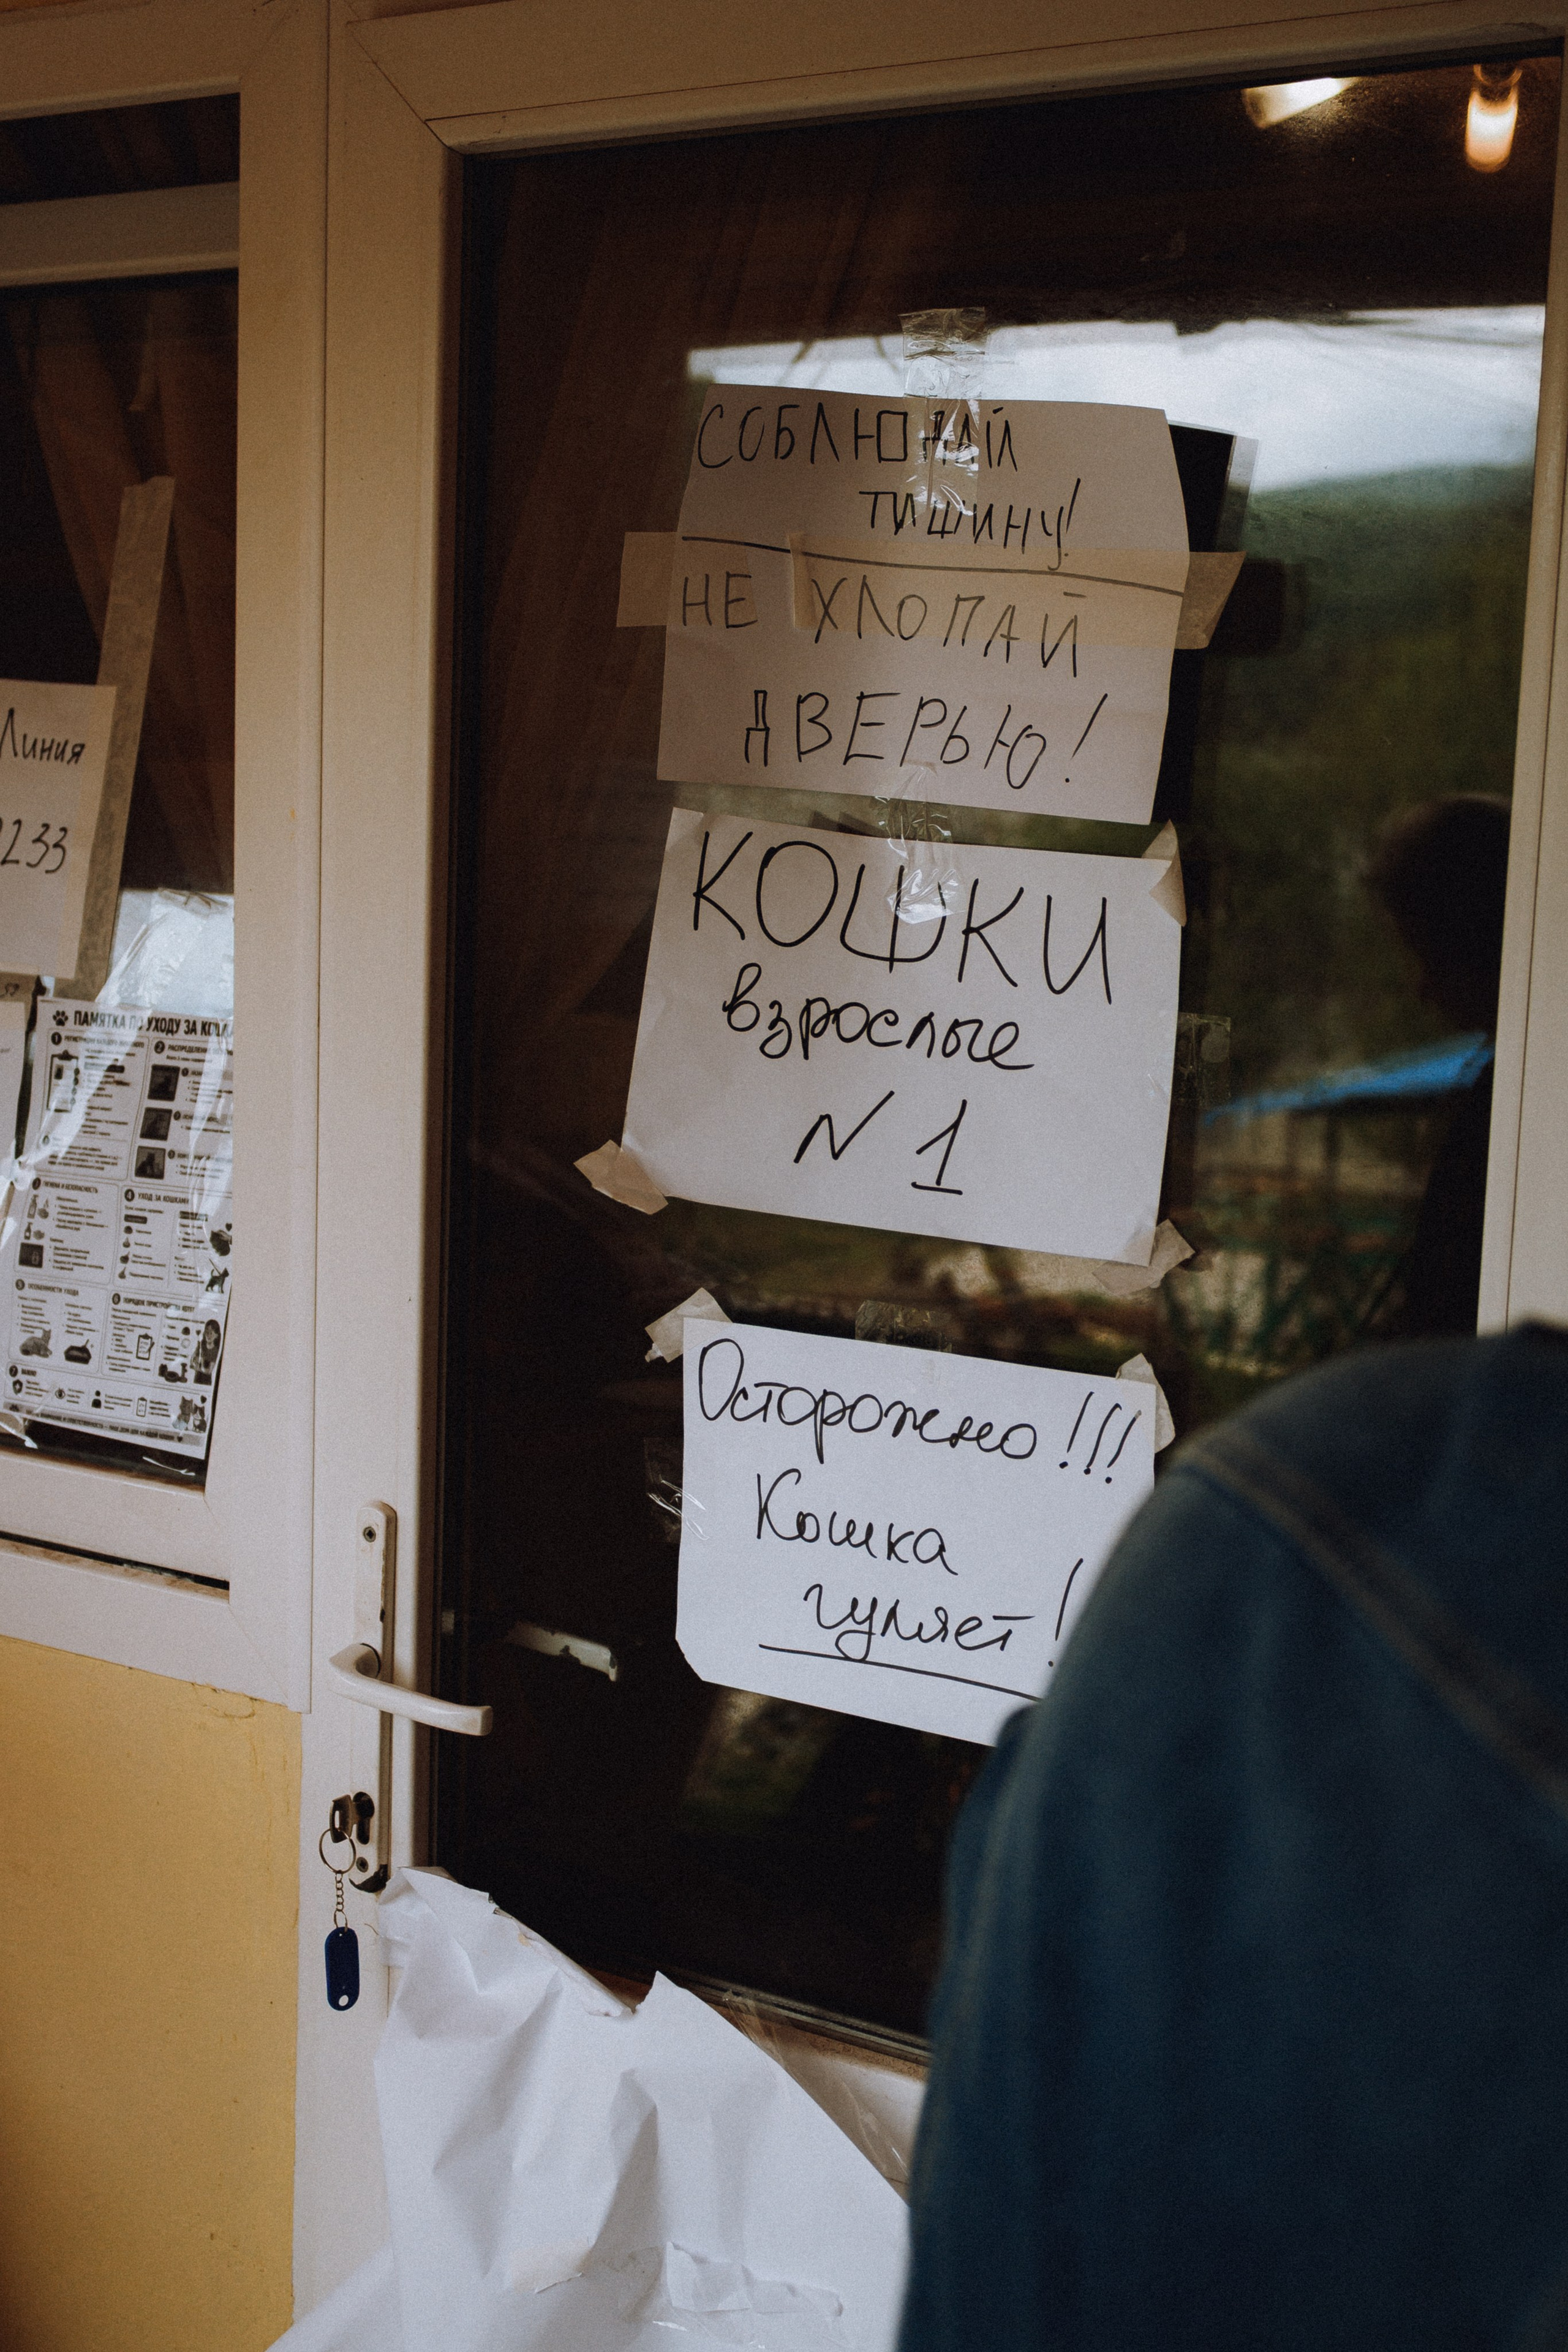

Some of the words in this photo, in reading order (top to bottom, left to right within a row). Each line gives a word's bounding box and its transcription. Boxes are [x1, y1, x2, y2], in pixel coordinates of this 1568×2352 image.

[697, 401, 1018, 472] СОБЛЮДАЙ
[681, 571, 758, 630] НЕ
[811, 575, 1087, 678] ХЛОПАЙ
[0, 707, 86, 764] Линия
[743, 689, 1108, 790] ДВЕРЬЮ!
[0, 818, 69, 874] 233
[692, 831, 1113, 1005] КОШКИ
[74, 1011, 126, 1029] ПАМЯТКА
[146, 1017, 181, 1036] УХОДУ
[184, 1019, 197, 1035] ЗА
[168, 1044, 212, 1054] РАСПРЕДЕЛЕНИ
[721, 962, 1035, 1071] взрослые
[910, 1099, 968, 1196] 1
[138, 1193, 153, 1202] УХОД
[162, 1196, 190, 1205] КОШКАМИ
[755, 1468, 959, 1577] Кошка
